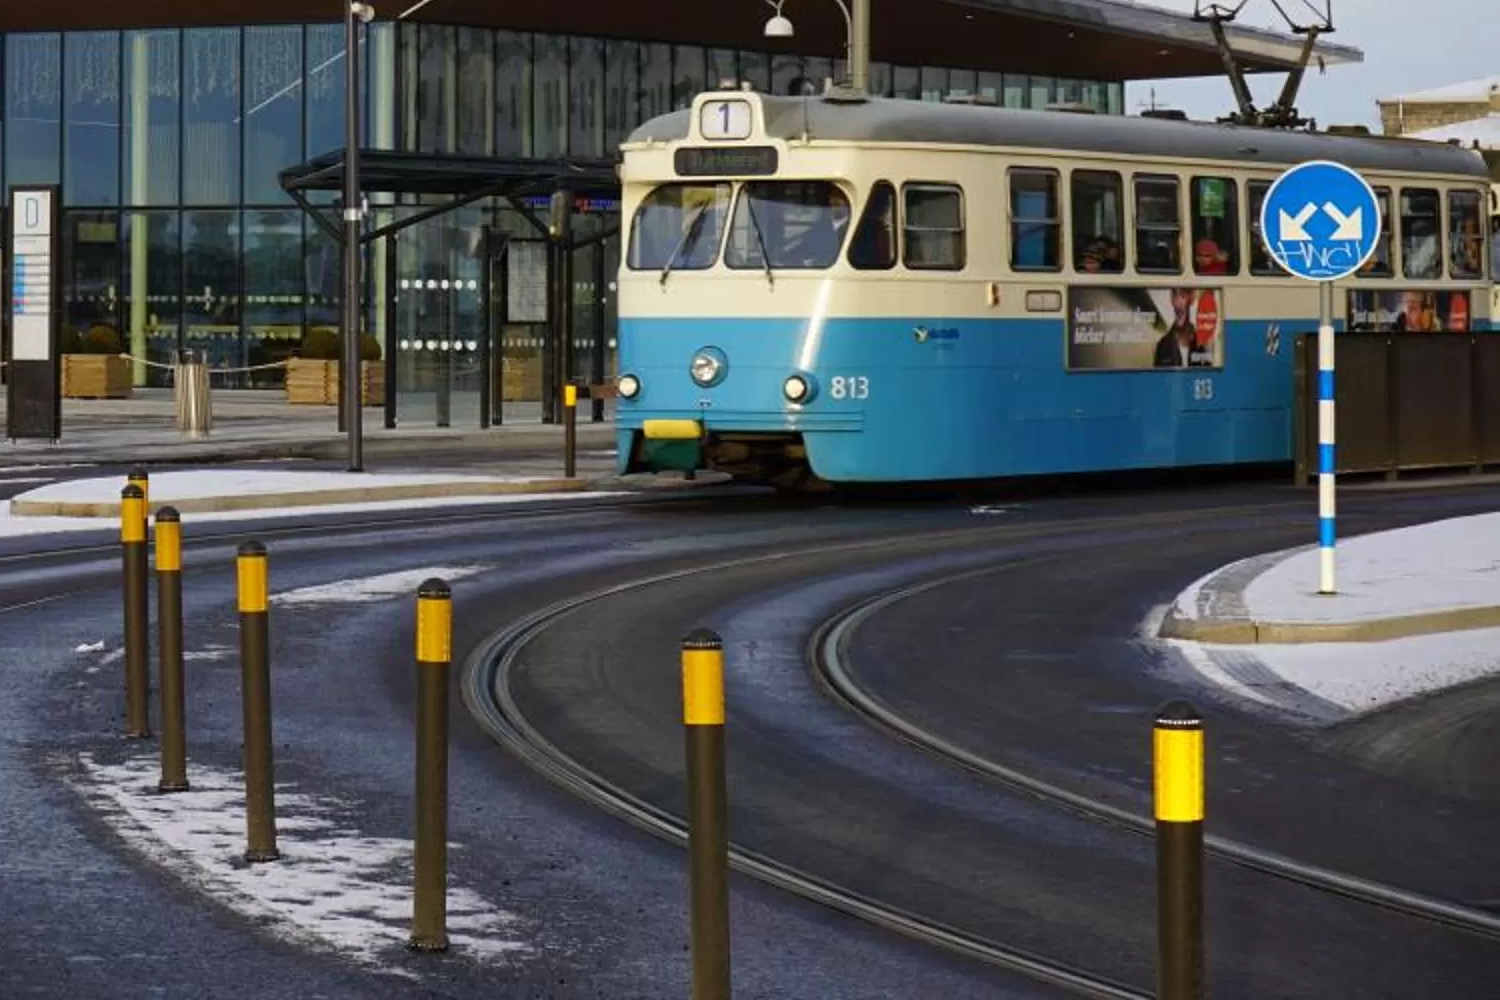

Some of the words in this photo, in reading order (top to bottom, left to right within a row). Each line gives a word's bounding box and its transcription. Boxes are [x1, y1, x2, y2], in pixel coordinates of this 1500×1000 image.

[718, 103, 729, 133] 1
[25, 197, 39, 229] D
[831, 375, 869, 399] 813
[1194, 378, 1213, 400] 813
